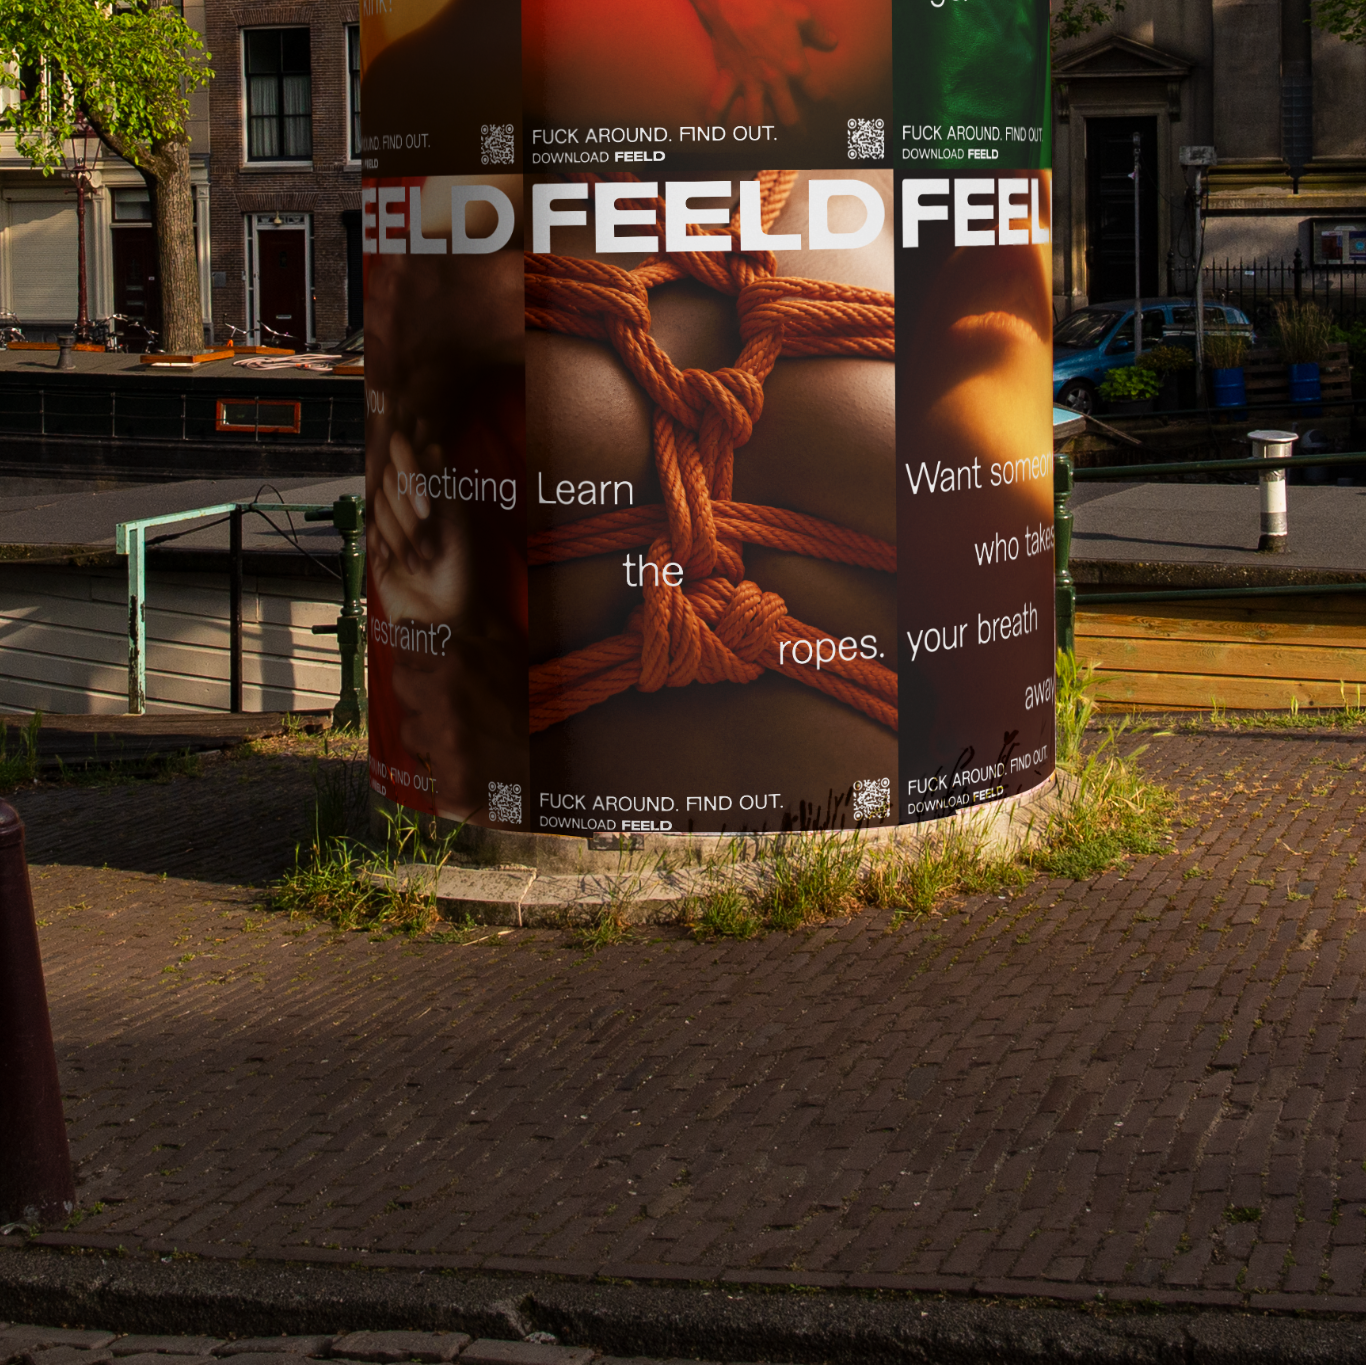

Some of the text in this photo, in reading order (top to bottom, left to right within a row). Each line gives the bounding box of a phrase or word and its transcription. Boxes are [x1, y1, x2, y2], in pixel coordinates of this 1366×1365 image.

[383, 134, 403, 150] FIND
[406, 133, 431, 149] OUT.
[532, 125, 778, 145] FUCK AROUND. FIND OUT.
[902, 125, 1044, 142] FUCK AROUND. FIND OUT.
[532, 150, 666, 164] DOWNLOAD FEELD
[902, 148, 999, 160] DOWNLOAD FEELD
[532, 179, 885, 254] FEELD
[902, 177, 1053, 249] FEEL
[396, 467, 517, 511] practicing
[538, 471, 634, 505] Learn
[905, 456, 983, 495] Want
[974, 532, 1019, 566] who
[622, 553, 684, 587] the
[370, 614, 452, 657] restraint?
[906, 601, 1038, 662] your breath
[779, 634, 885, 670] ropes.
[390, 766, 411, 787] FIND
[908, 744, 1048, 796] FUCK AROUND. FIND OUT.
[539, 792, 784, 812] FUCK AROUND. FIND OUT.
[907, 785, 1004, 815] DOWNLOAD FEELD
[539, 815, 673, 831] DOWNLOAD FEELD
